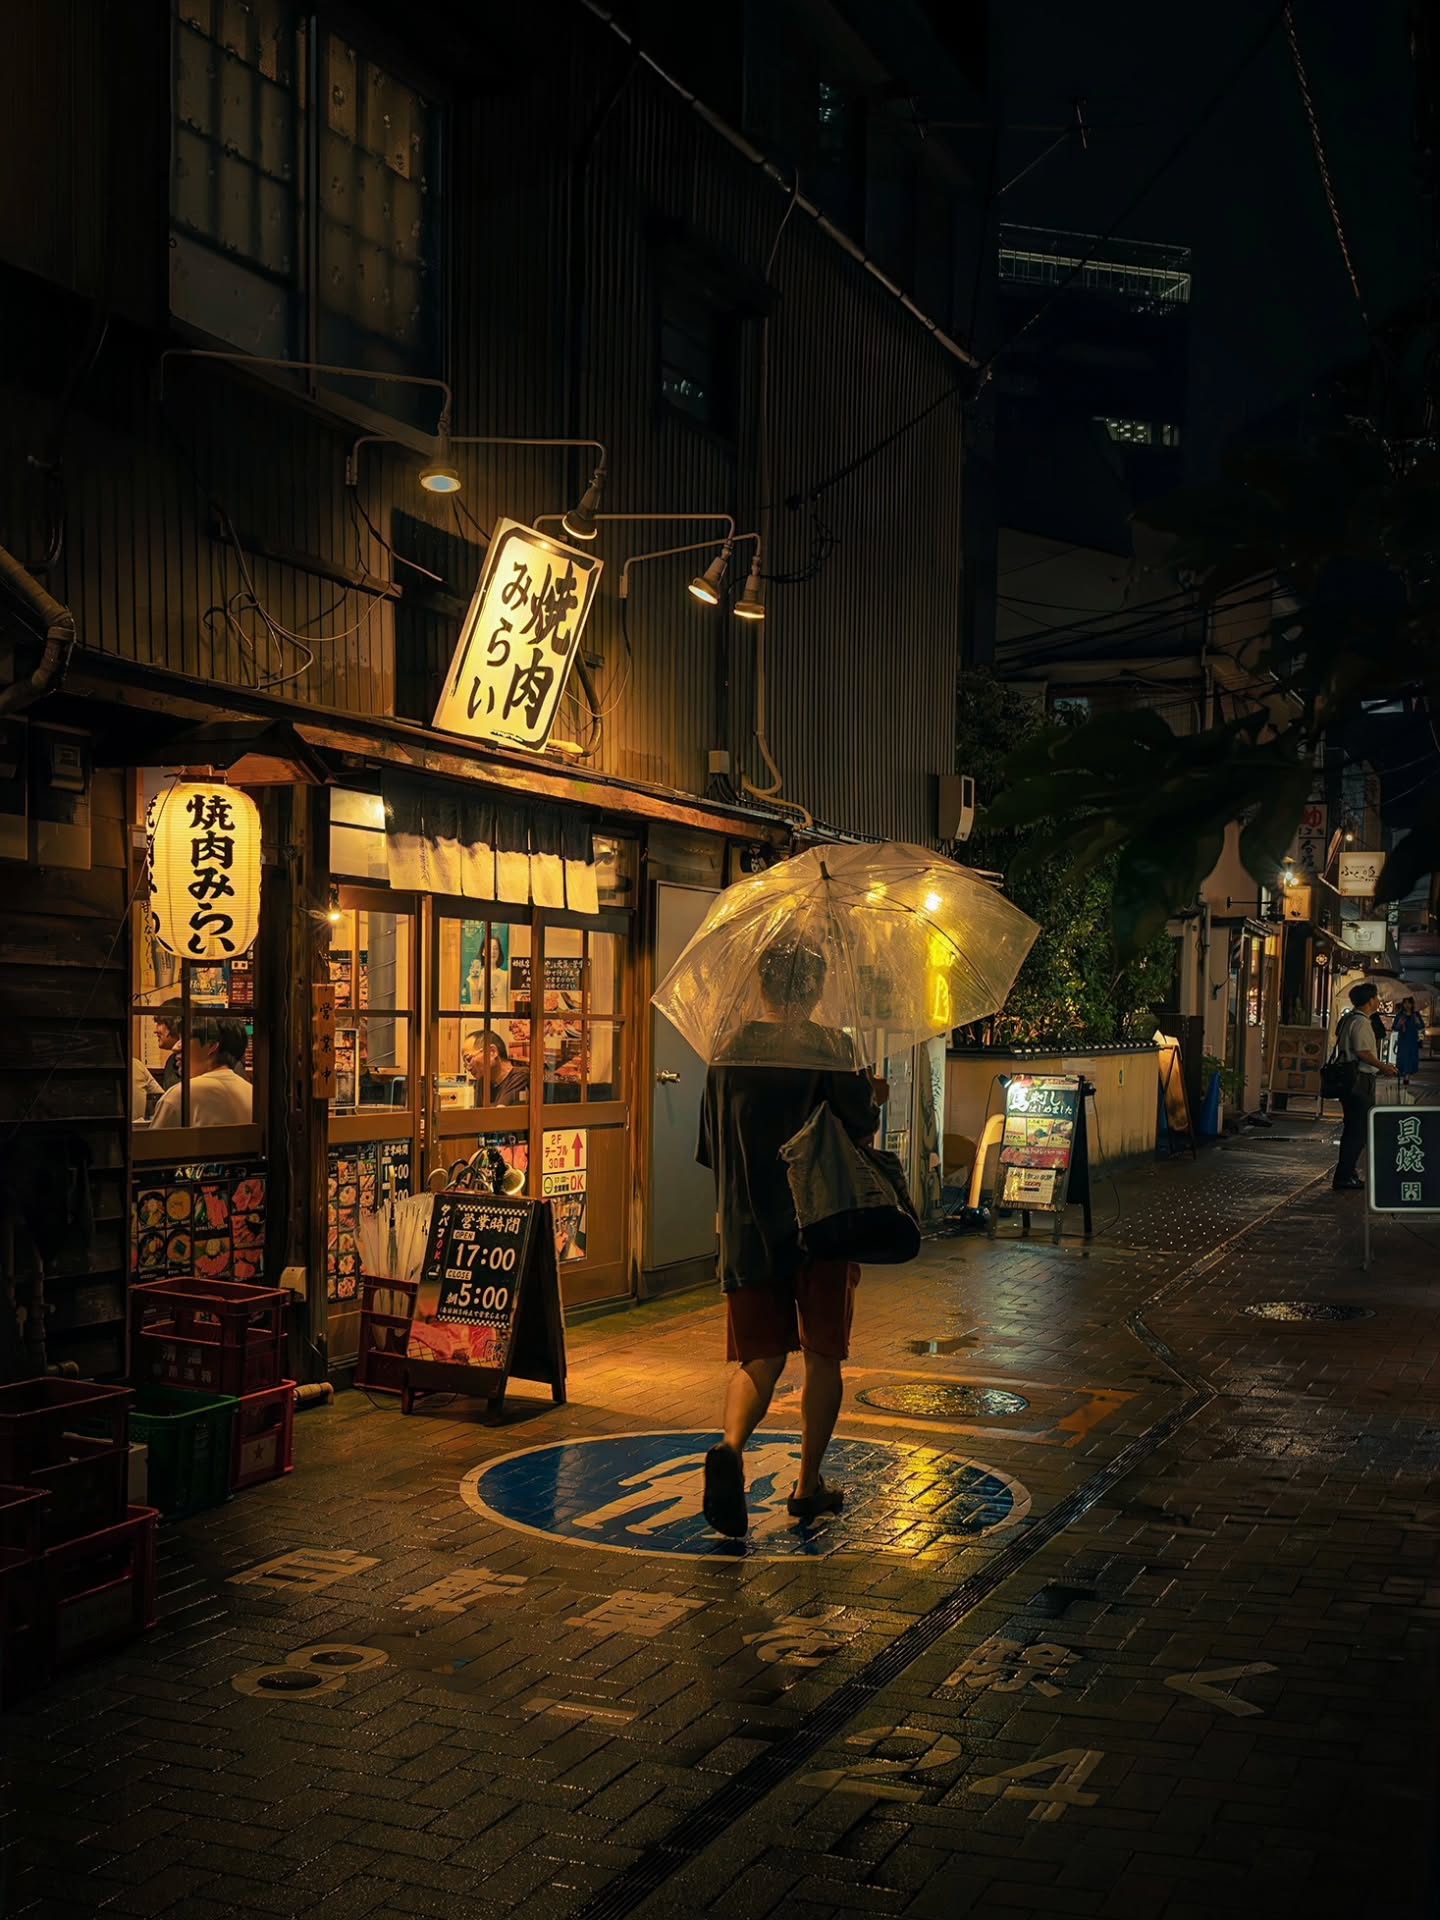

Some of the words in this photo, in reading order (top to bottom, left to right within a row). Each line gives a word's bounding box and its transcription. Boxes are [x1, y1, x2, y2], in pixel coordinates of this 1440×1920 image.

[467, 562, 532, 720] みらい
[503, 560, 578, 729] 焼肉
[187, 794, 236, 954] 焼肉みらい
[320, 1002, 333, 1086] 営業中
[1396, 1116, 1425, 1173] 貝焼
[570, 1175, 584, 1191] OK
[439, 1204, 451, 1237] タバコ
[455, 1231, 474, 1240] OPEN
[461, 1213, 521, 1235] 営業時間
[455, 1243, 517, 1272] 17:00
[447, 1270, 471, 1280] CLOSE
